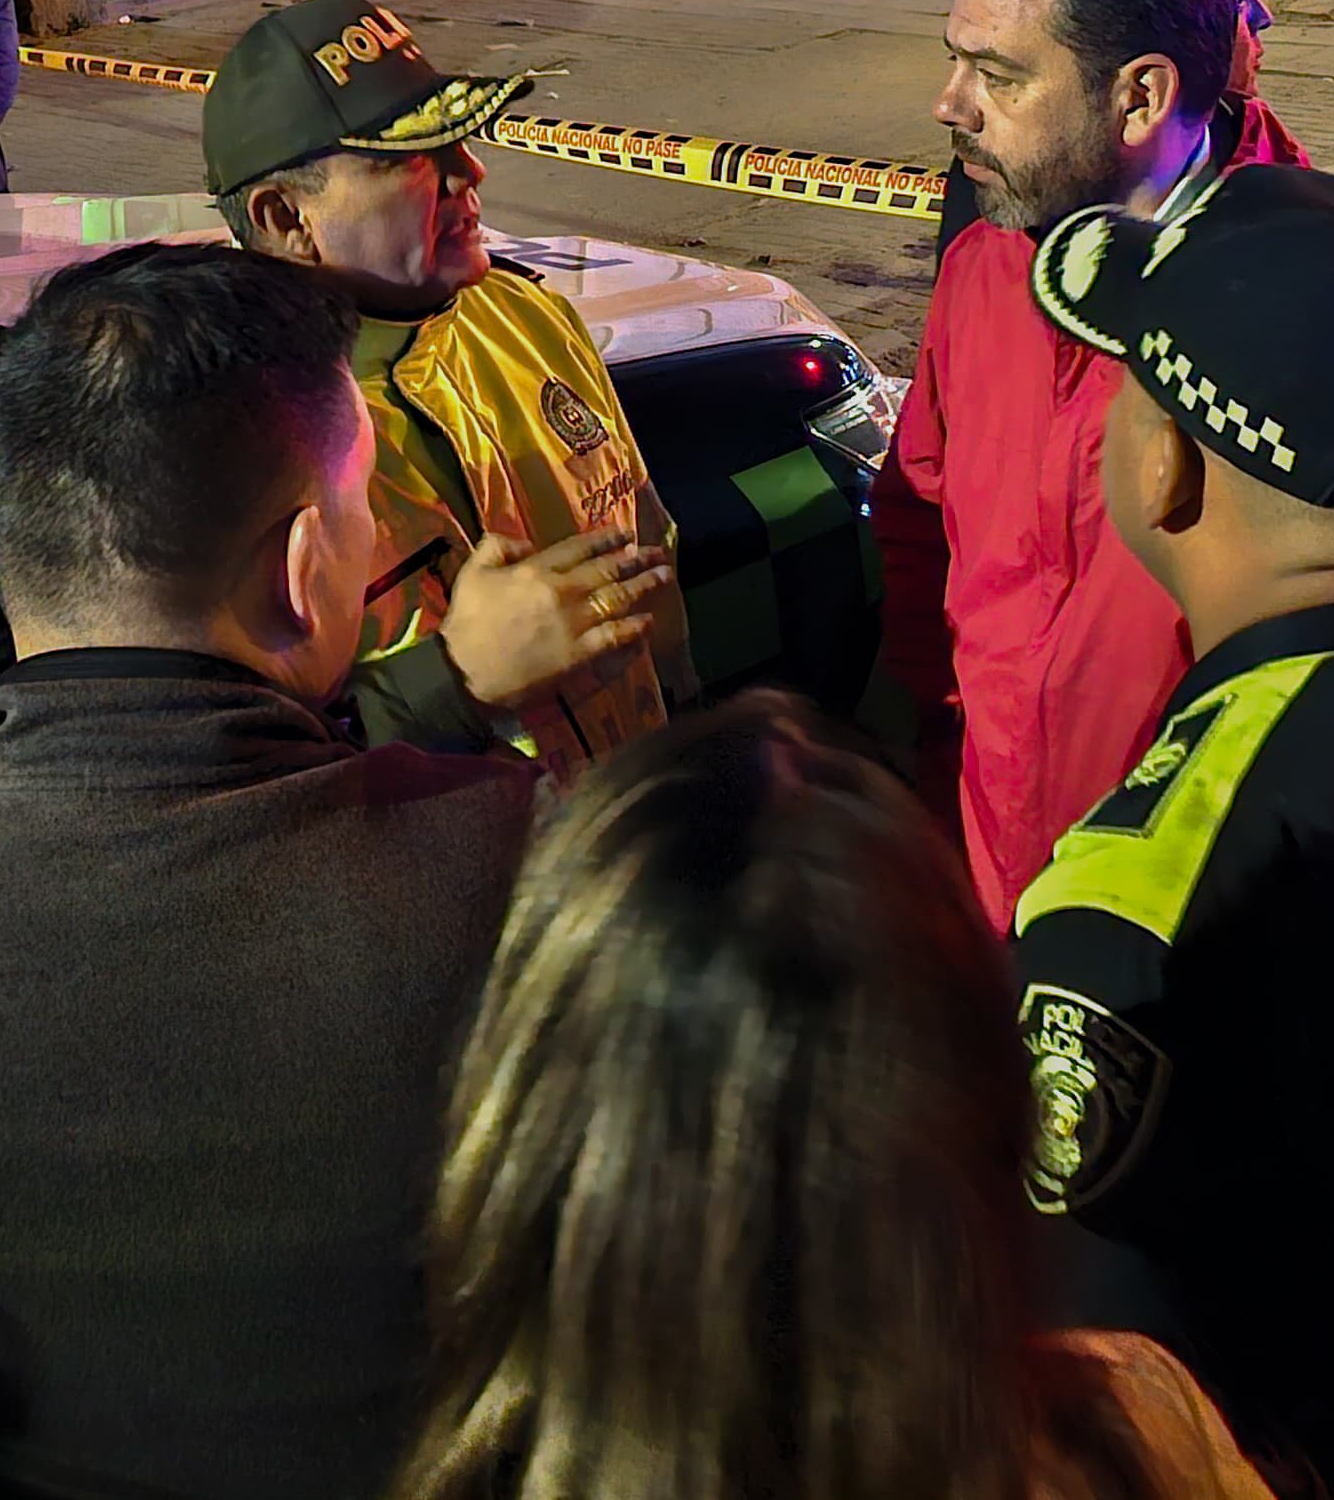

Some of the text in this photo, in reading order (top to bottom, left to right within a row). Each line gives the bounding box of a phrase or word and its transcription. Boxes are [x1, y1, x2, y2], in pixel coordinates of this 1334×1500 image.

[552, 128, 618, 153] NACIONAL
[623, 137, 643, 155] NO
[645, 139, 682, 159] PASE
[805, 161, 881, 188] NACIONAL
[885, 172, 911, 192] NO
